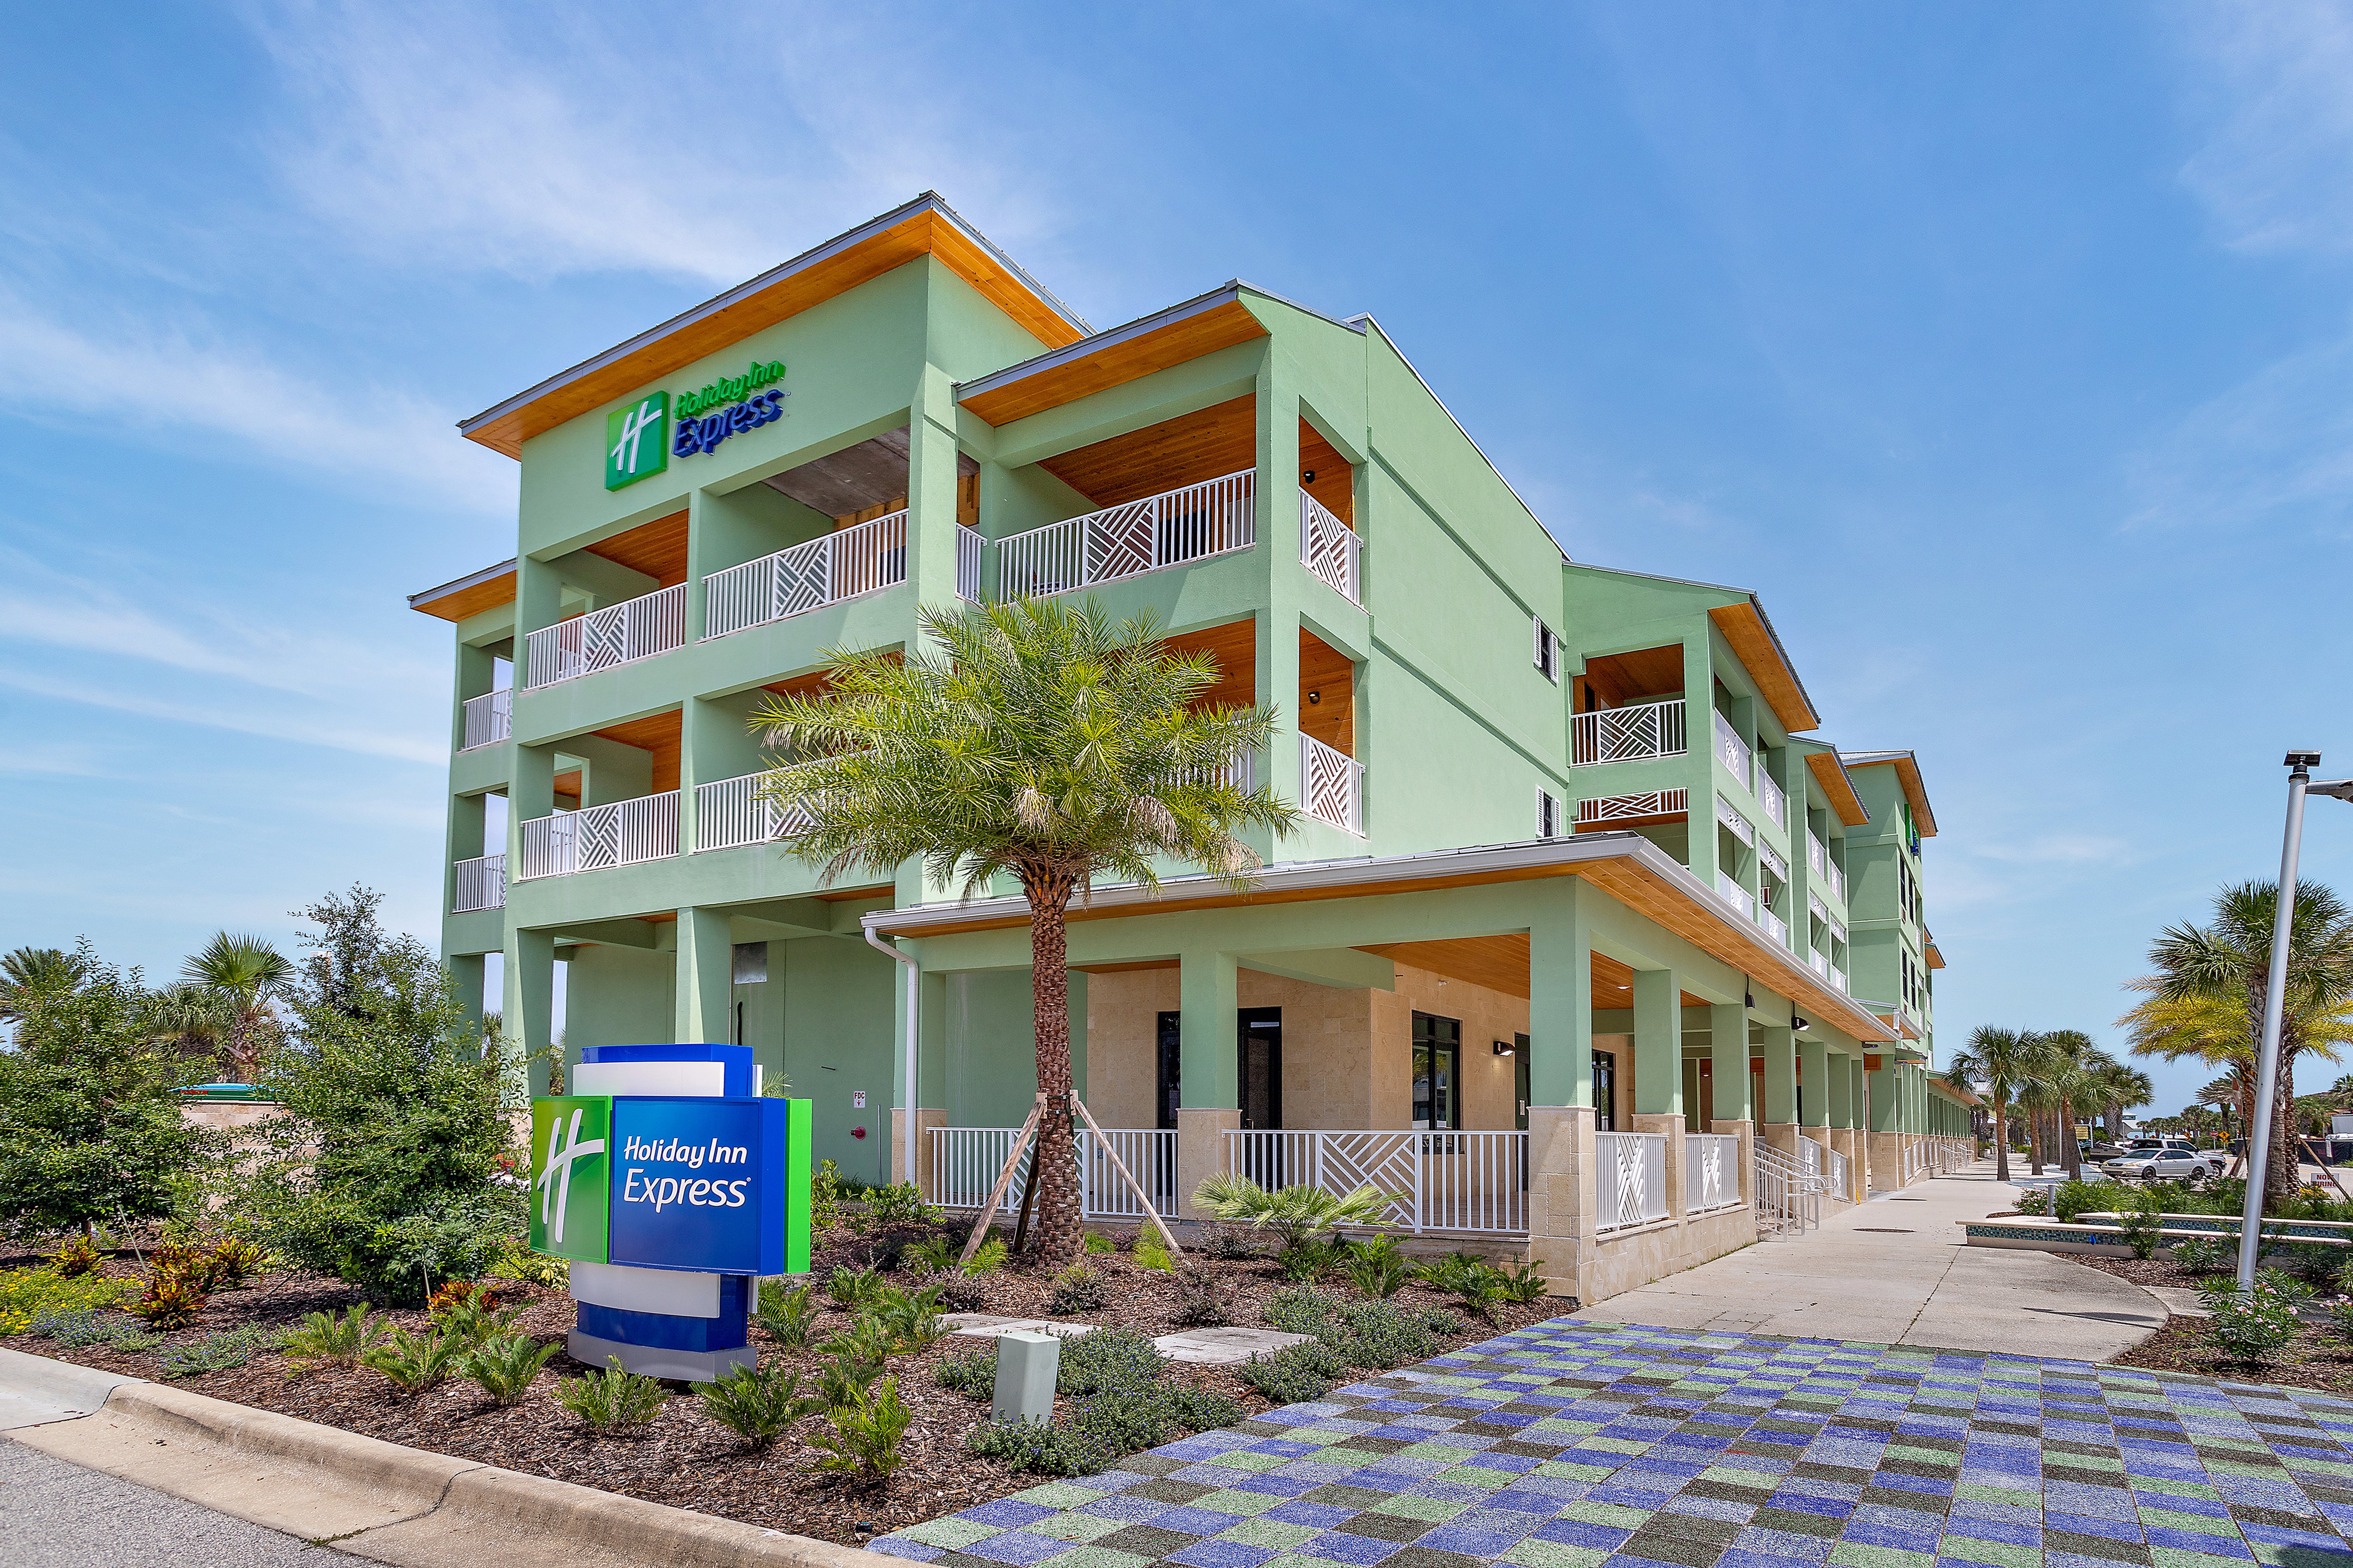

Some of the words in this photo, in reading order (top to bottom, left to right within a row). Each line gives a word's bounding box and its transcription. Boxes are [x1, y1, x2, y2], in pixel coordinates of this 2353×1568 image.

[674, 374, 750, 420] Holiday
[747, 361, 786, 389] Inn
[673, 389, 785, 458] Express
[623, 1136, 706, 1169] Holiday
[708, 1138, 748, 1164] Inn
